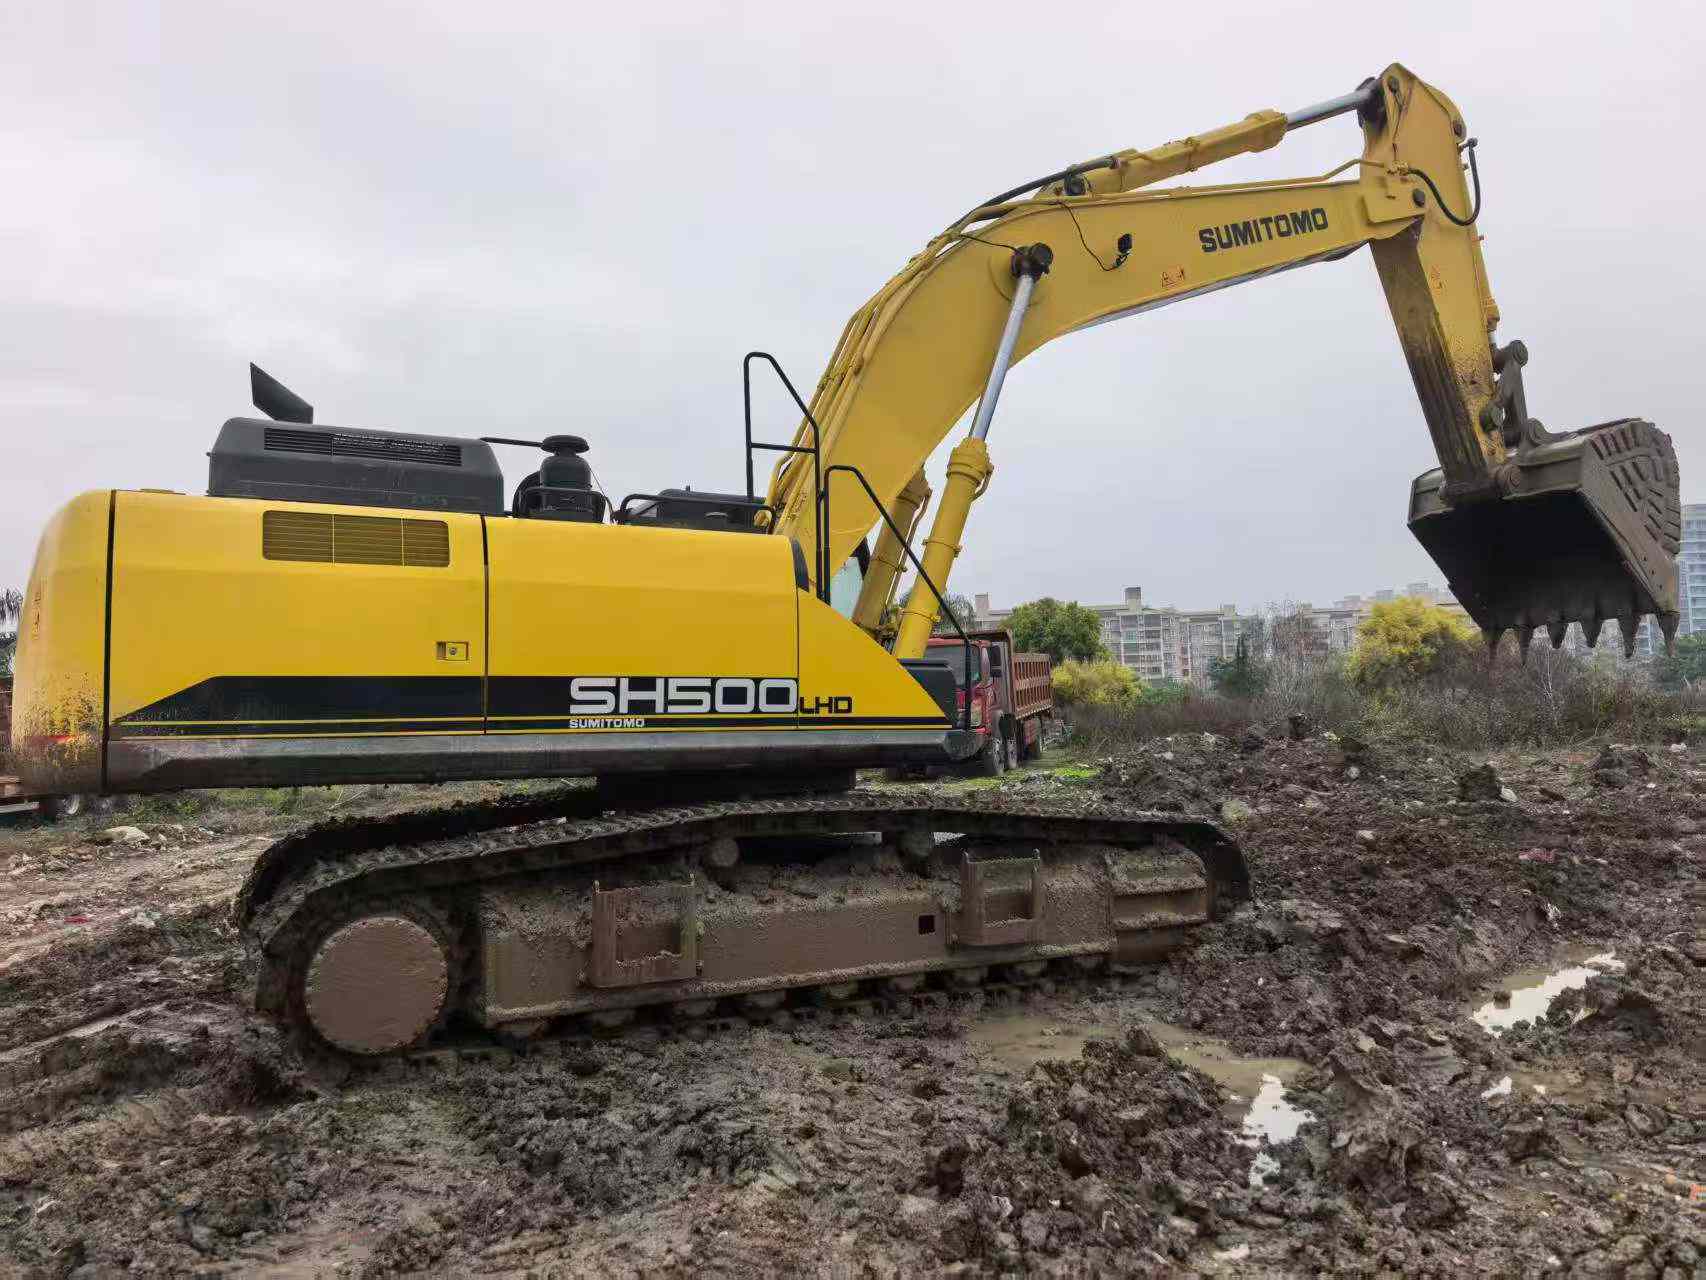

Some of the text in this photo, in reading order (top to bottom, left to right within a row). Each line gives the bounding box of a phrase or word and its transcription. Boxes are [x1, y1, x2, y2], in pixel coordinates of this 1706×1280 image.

[1199, 207, 1328, 252] SUMITOMO
[569, 677, 853, 714] SH500 LHD
[568, 718, 645, 728] SUMITOMO
